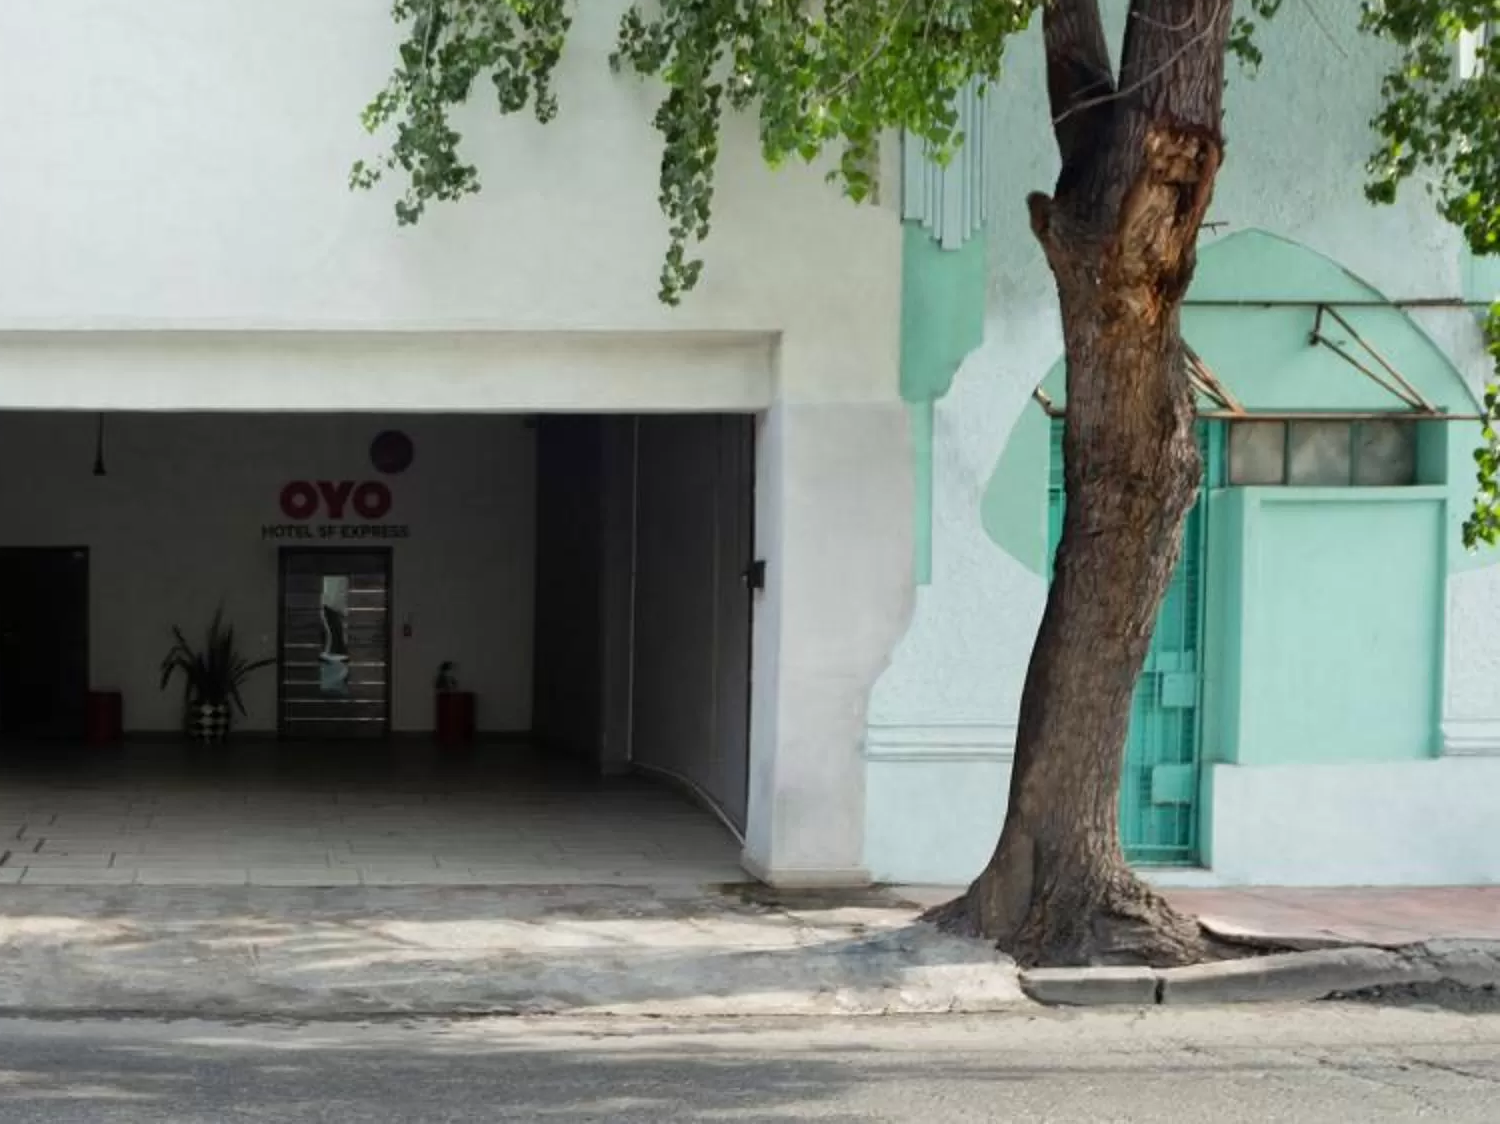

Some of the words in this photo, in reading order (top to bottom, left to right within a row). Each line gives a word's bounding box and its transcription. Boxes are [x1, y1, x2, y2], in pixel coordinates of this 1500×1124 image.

[279, 479, 392, 519] OYO
[261, 524, 312, 538] HOTEL
[341, 524, 411, 538] EXPRESS
